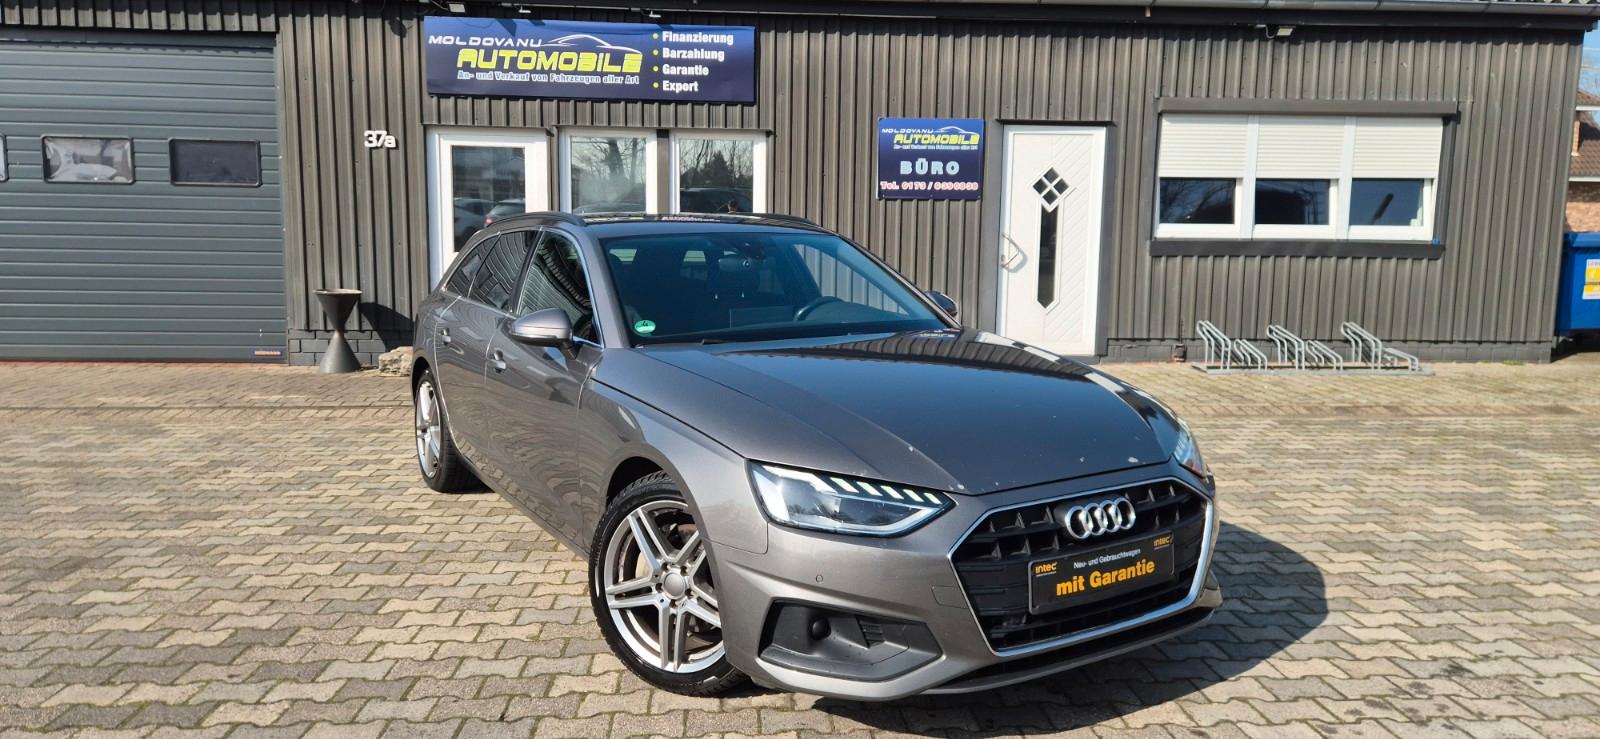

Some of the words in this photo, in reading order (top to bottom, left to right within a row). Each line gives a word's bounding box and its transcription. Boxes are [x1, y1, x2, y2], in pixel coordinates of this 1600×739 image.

[427, 34, 543, 48] MOLDOVANU
[662, 30, 734, 46] Finanzierung
[456, 48, 643, 73] AUTOMOBILE
[662, 47, 725, 62] Barzahlung
[662, 63, 710, 76] Garantie
[457, 70, 475, 80] An-
[476, 71, 494, 81] und
[494, 71, 530, 82] Verkauf
[531, 73, 548, 82] von
[549, 73, 601, 85] Fahrzeugen
[602, 74, 624, 84] aller
[624, 75, 640, 85] Art
[662, 80, 699, 93] Export
[363, 130, 397, 148] 37a
[899, 157, 960, 175] BÜRO
[880, 180, 900, 190] Tel.
[1087, 557, 1099, 566] und
[1098, 548, 1141, 563] Gebrauchtwagen
[1056, 574, 1085, 596] mit
[1089, 558, 1156, 588] Garantie
